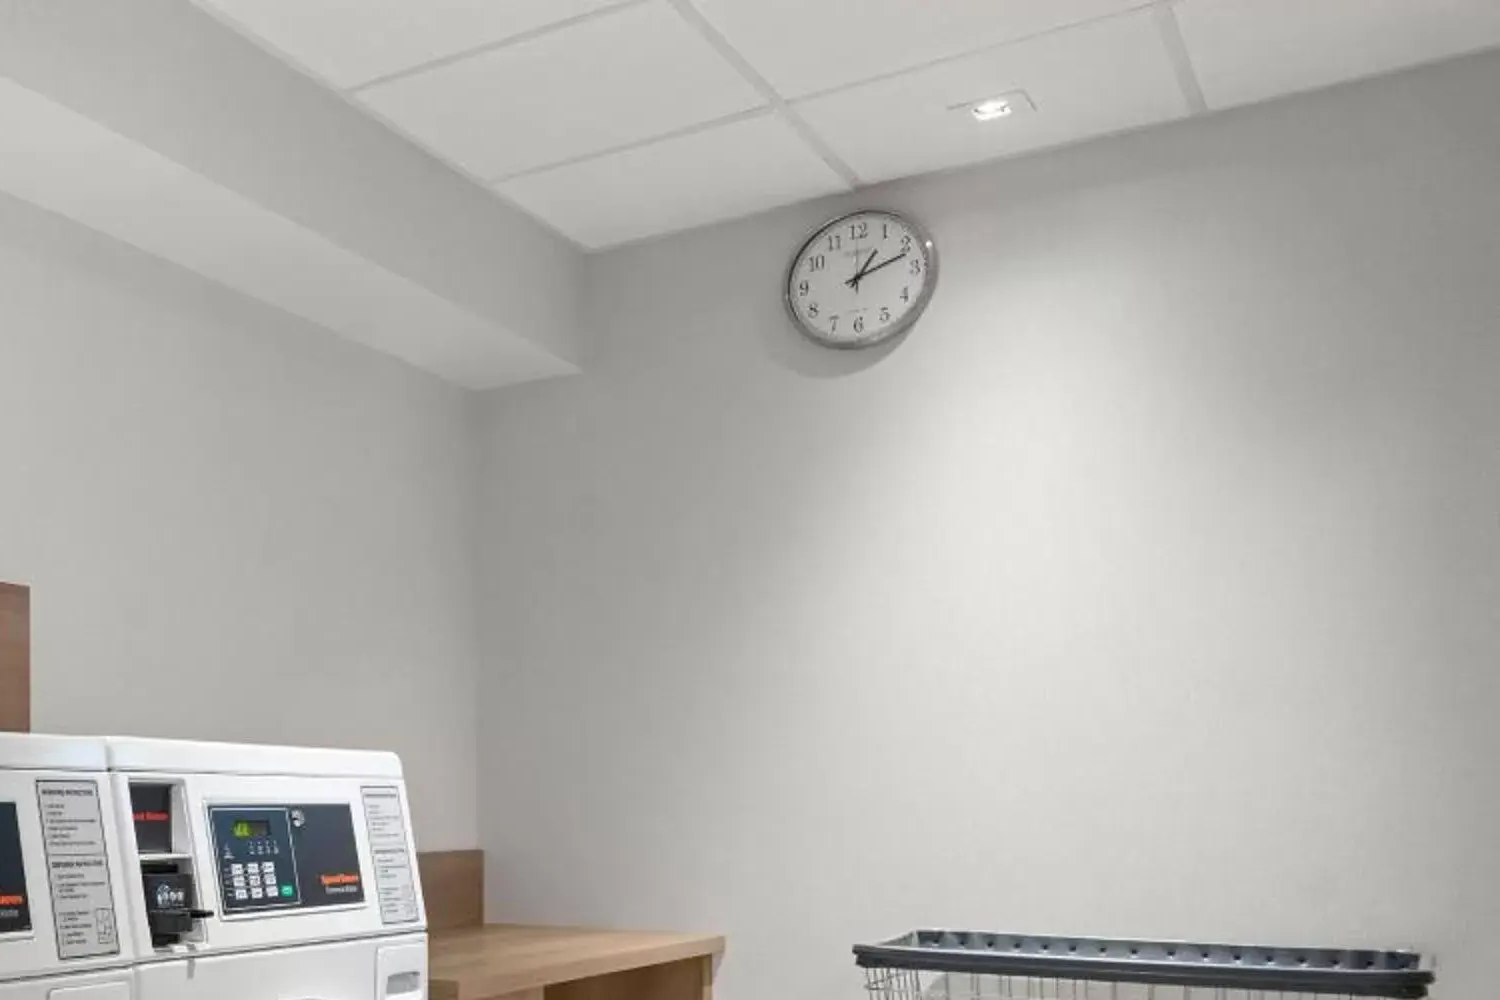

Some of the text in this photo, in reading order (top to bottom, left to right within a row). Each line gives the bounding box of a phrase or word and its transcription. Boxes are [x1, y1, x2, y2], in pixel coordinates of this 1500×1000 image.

[849, 222, 868, 240] 12
[827, 235, 841, 252] 11
[899, 235, 912, 254] 2
[809, 255, 825, 273] 10
[909, 258, 921, 276] 3
[799, 279, 809, 296] 9
[899, 286, 909, 304] 4
[807, 302, 819, 319] 8
[879, 306, 891, 321] 5
[827, 314, 840, 335] 7
[852, 315, 864, 334] 6
